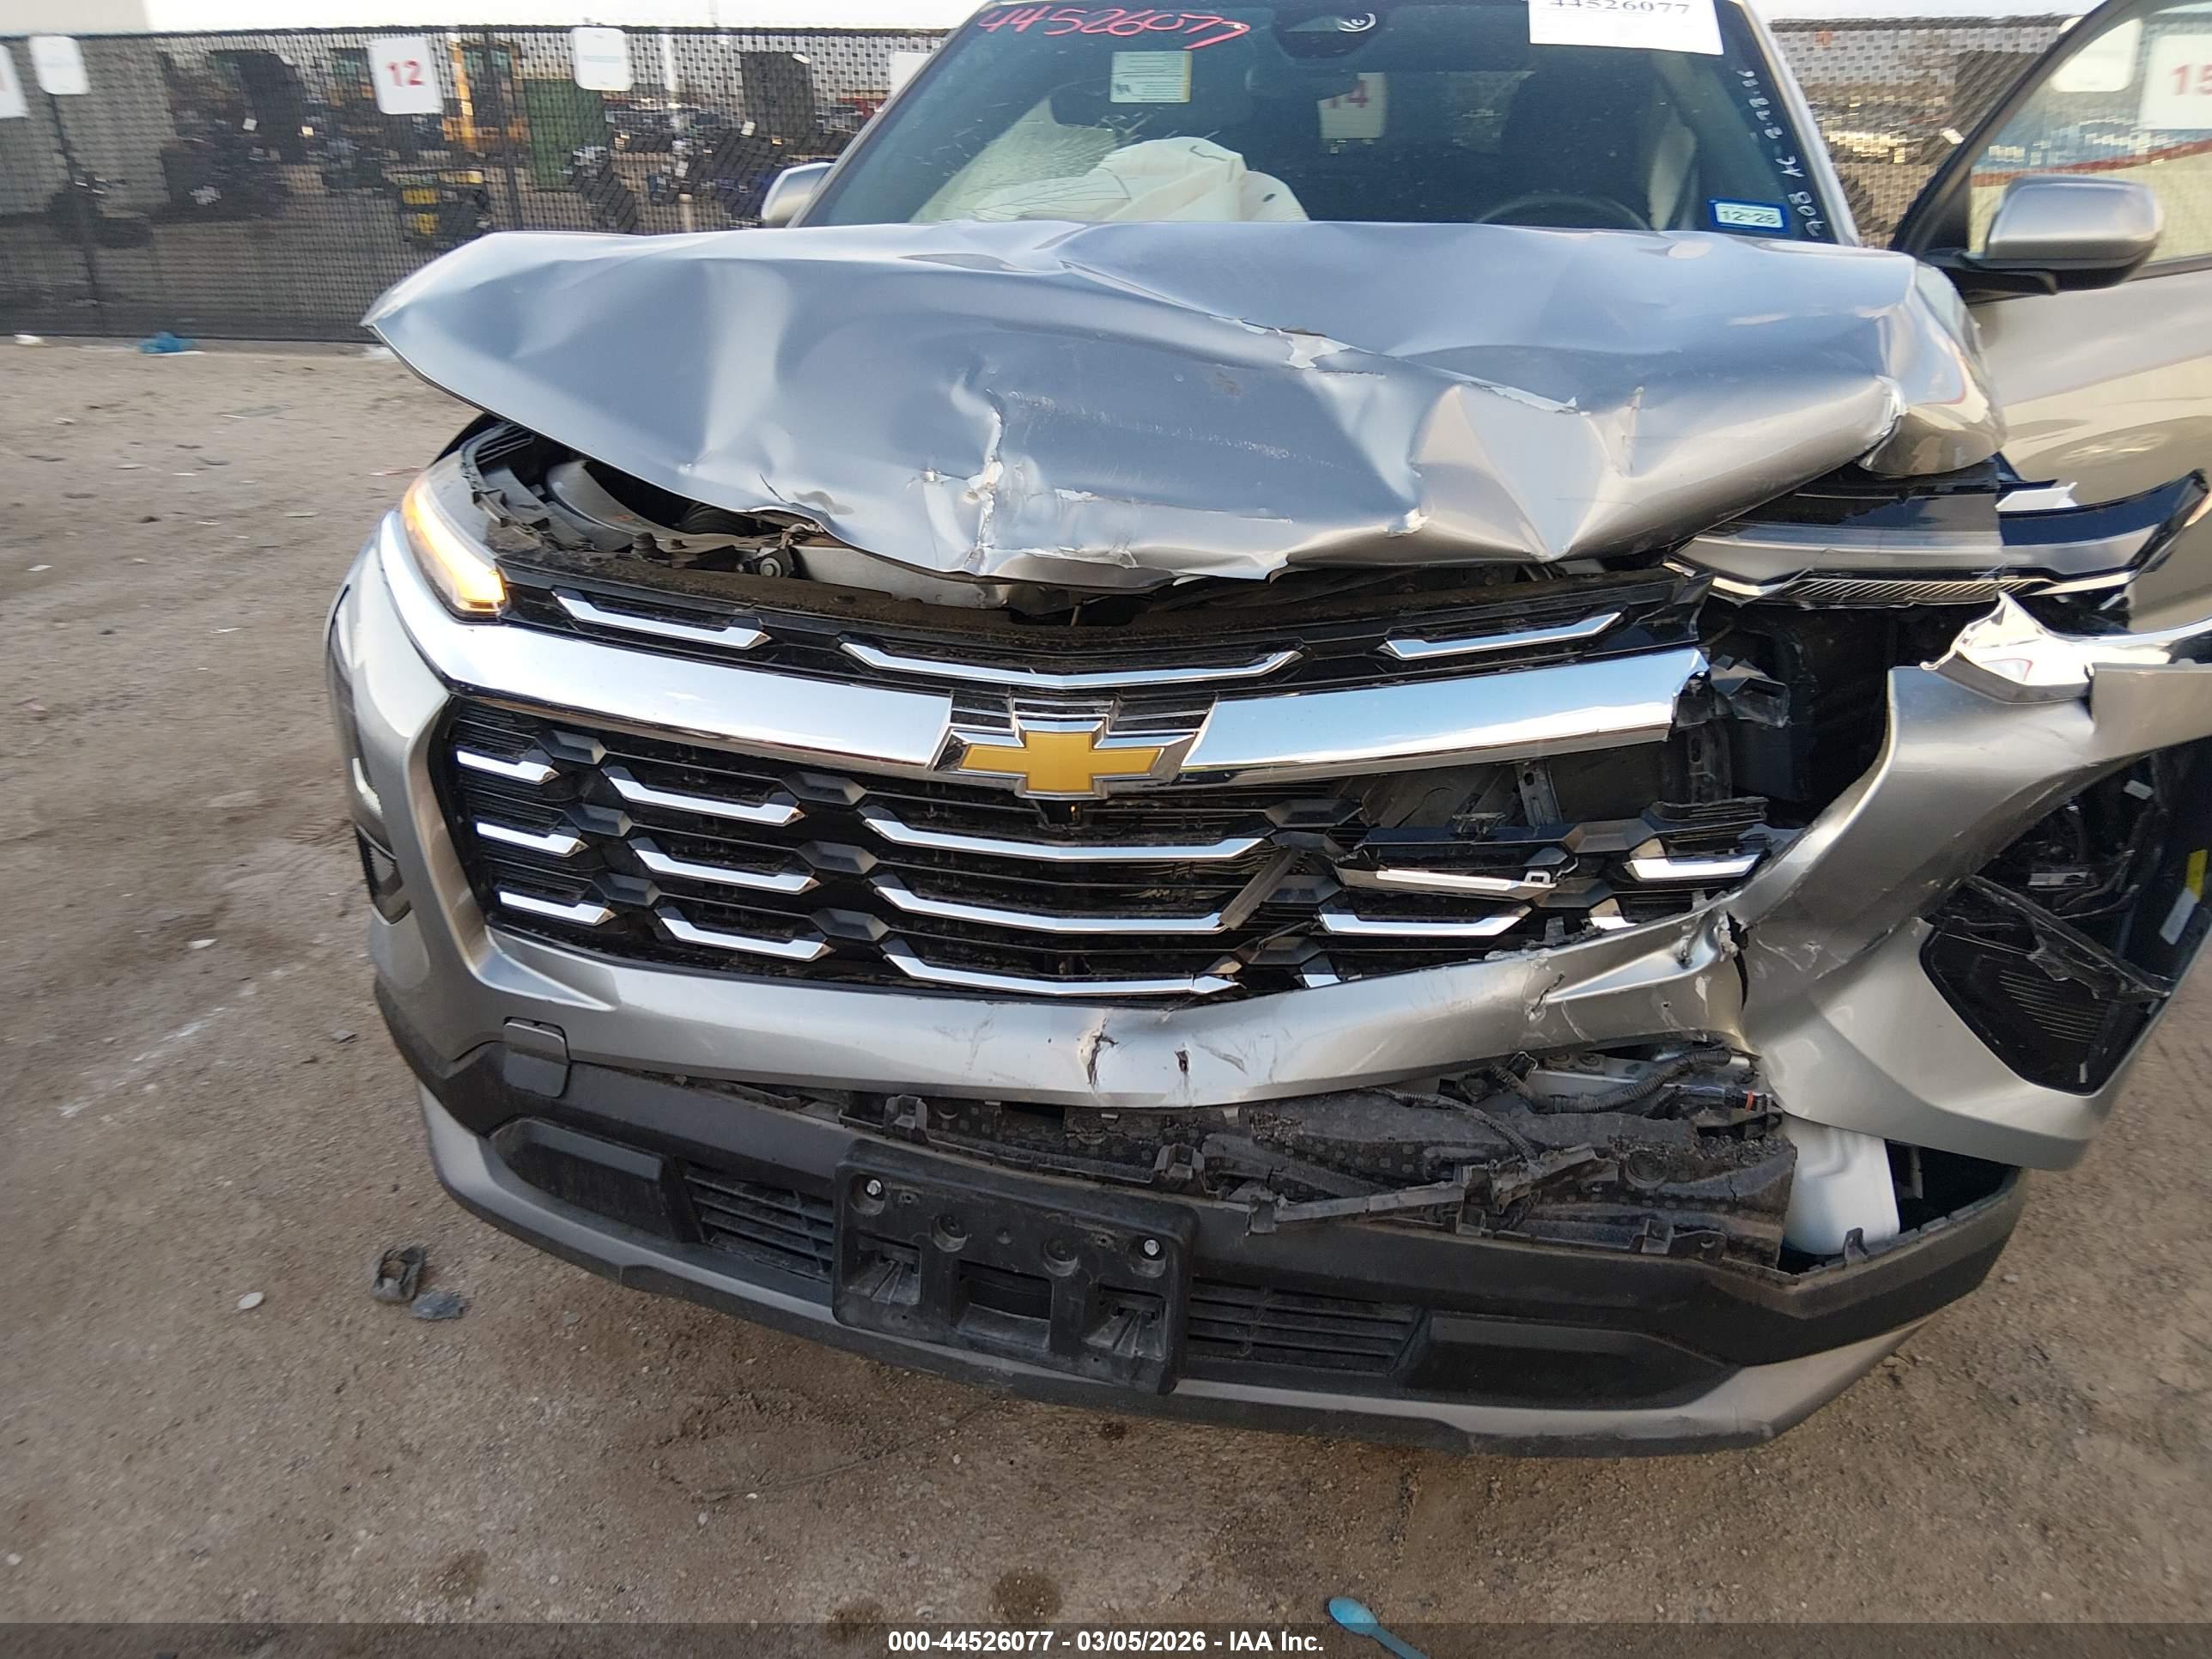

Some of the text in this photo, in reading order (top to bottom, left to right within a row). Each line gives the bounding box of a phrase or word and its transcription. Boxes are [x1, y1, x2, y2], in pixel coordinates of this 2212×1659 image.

[1550, 0, 1691, 15] 44526077
[977, 5, 1251, 50] 44526077
[386, 59, 426, 87] 12
